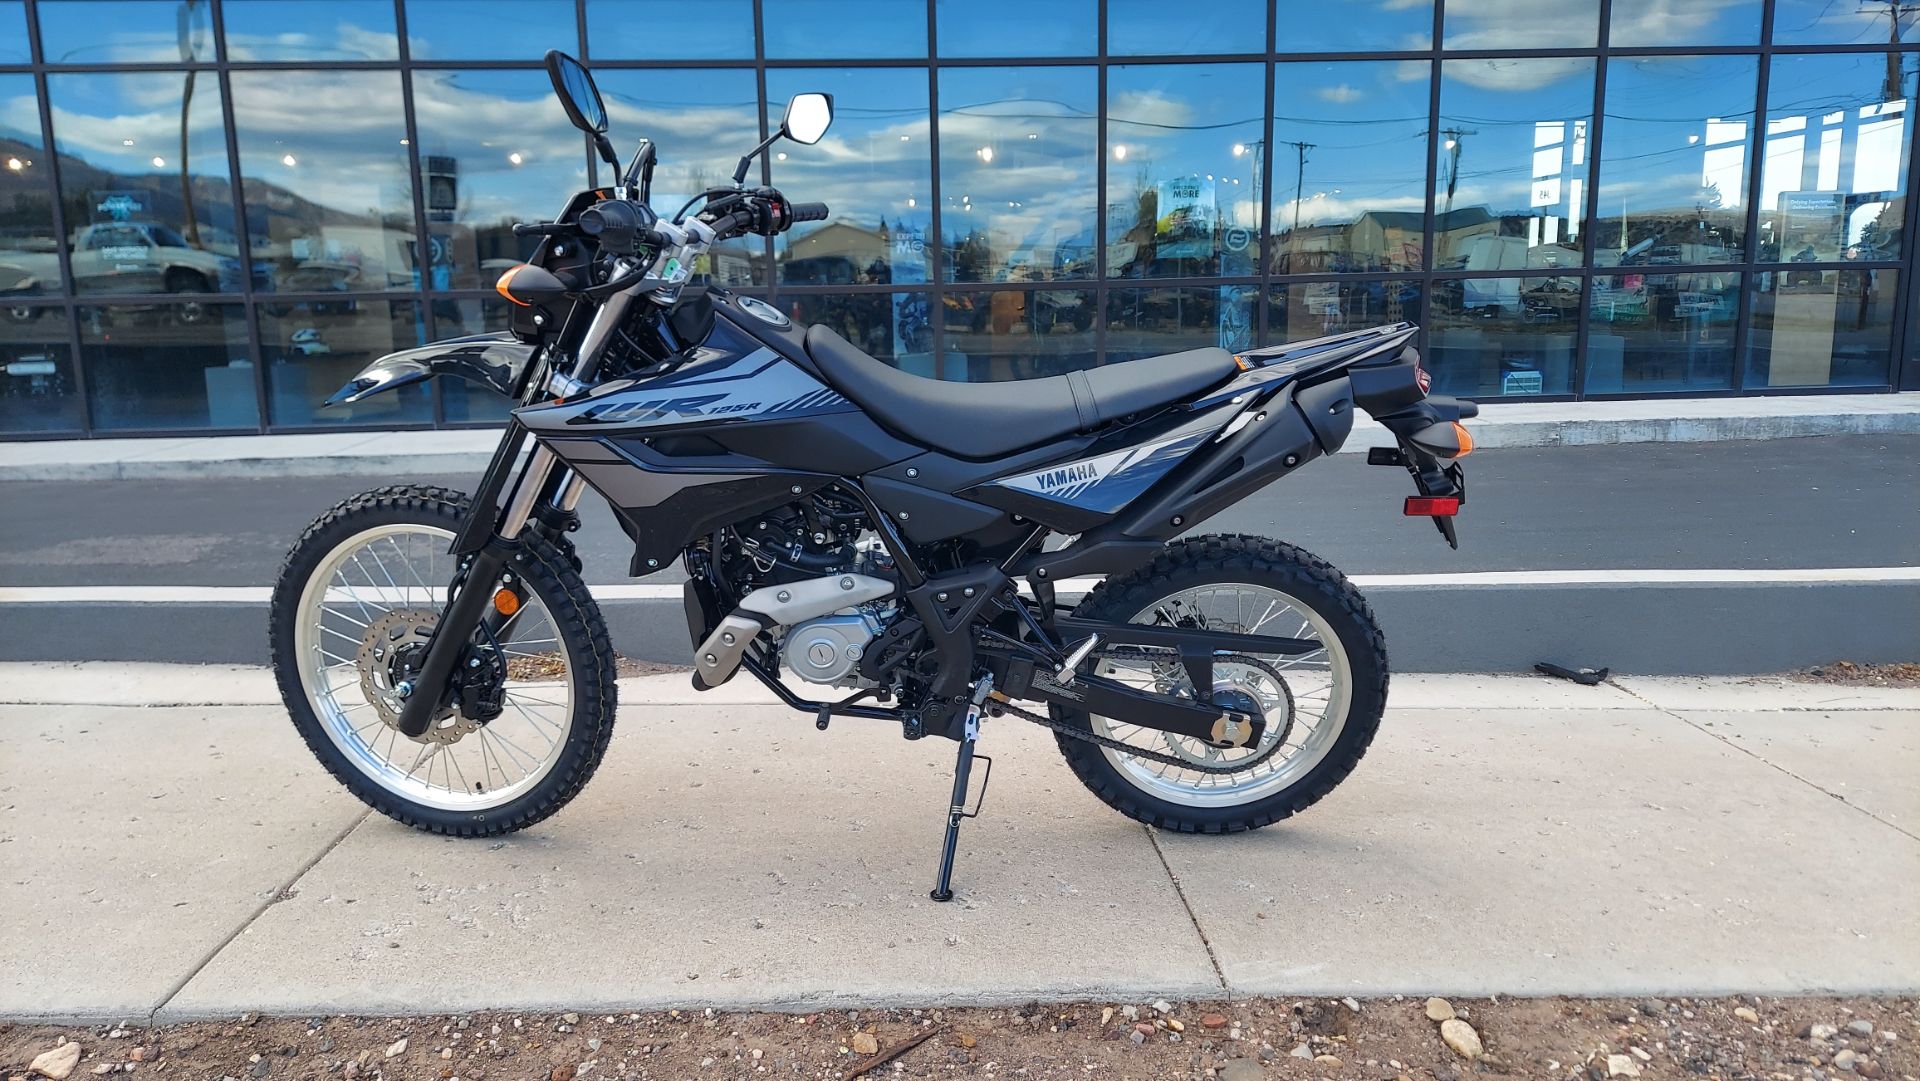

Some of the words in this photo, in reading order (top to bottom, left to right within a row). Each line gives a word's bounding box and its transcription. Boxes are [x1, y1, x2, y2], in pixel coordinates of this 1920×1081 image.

[1173, 190, 1200, 199] MORE
[707, 402, 762, 415] 125R
[1036, 462, 1098, 489] YAMAHA
